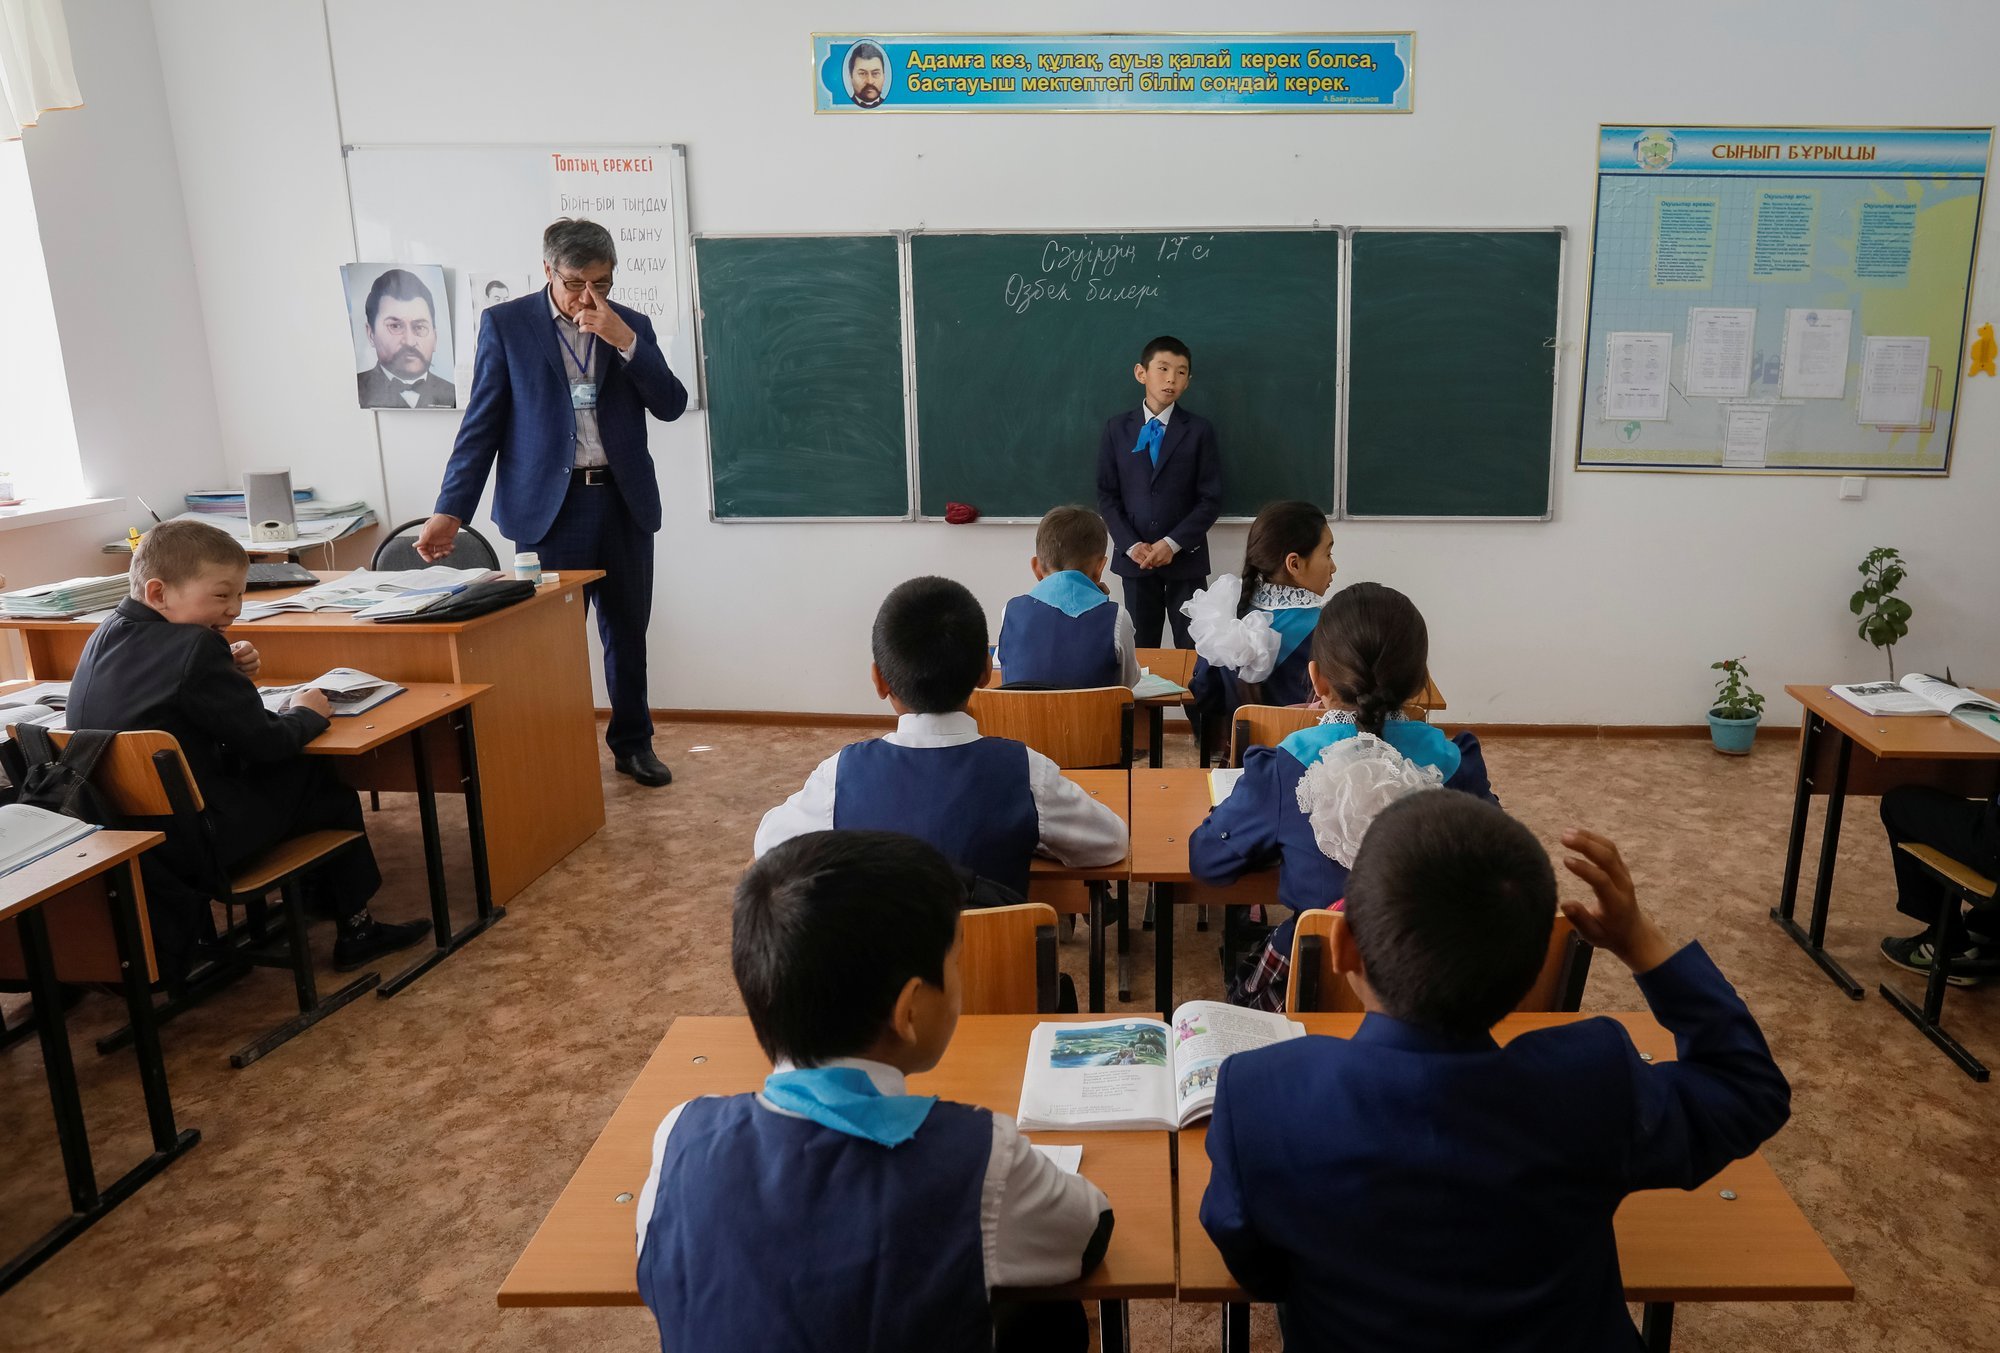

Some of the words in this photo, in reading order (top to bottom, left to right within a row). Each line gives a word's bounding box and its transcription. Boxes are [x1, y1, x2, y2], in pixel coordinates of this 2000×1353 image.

[907, 50, 985, 71] Адамға
[991, 53, 1032, 71] көз,
[1038, 53, 1104, 73] құлақ,
[1109, 53, 1163, 73] ауыз
[1169, 50, 1232, 71] қалай
[1241, 53, 1301, 72] керек
[1307, 50, 1378, 72] болса,
[908, 73, 1015, 96] бастауыш
[1022, 74, 1133, 93] мектептегі
[1139, 73, 1194, 92] білім
[1201, 72, 1278, 94] сондай
[1285, 75, 1350, 95] керек.
[1712, 144, 1781, 160] СЫНЫП
[1788, 145, 1876, 161] БҰРЫШЫ
[607, 286, 659, 302] ЕЛСЕНДІ
